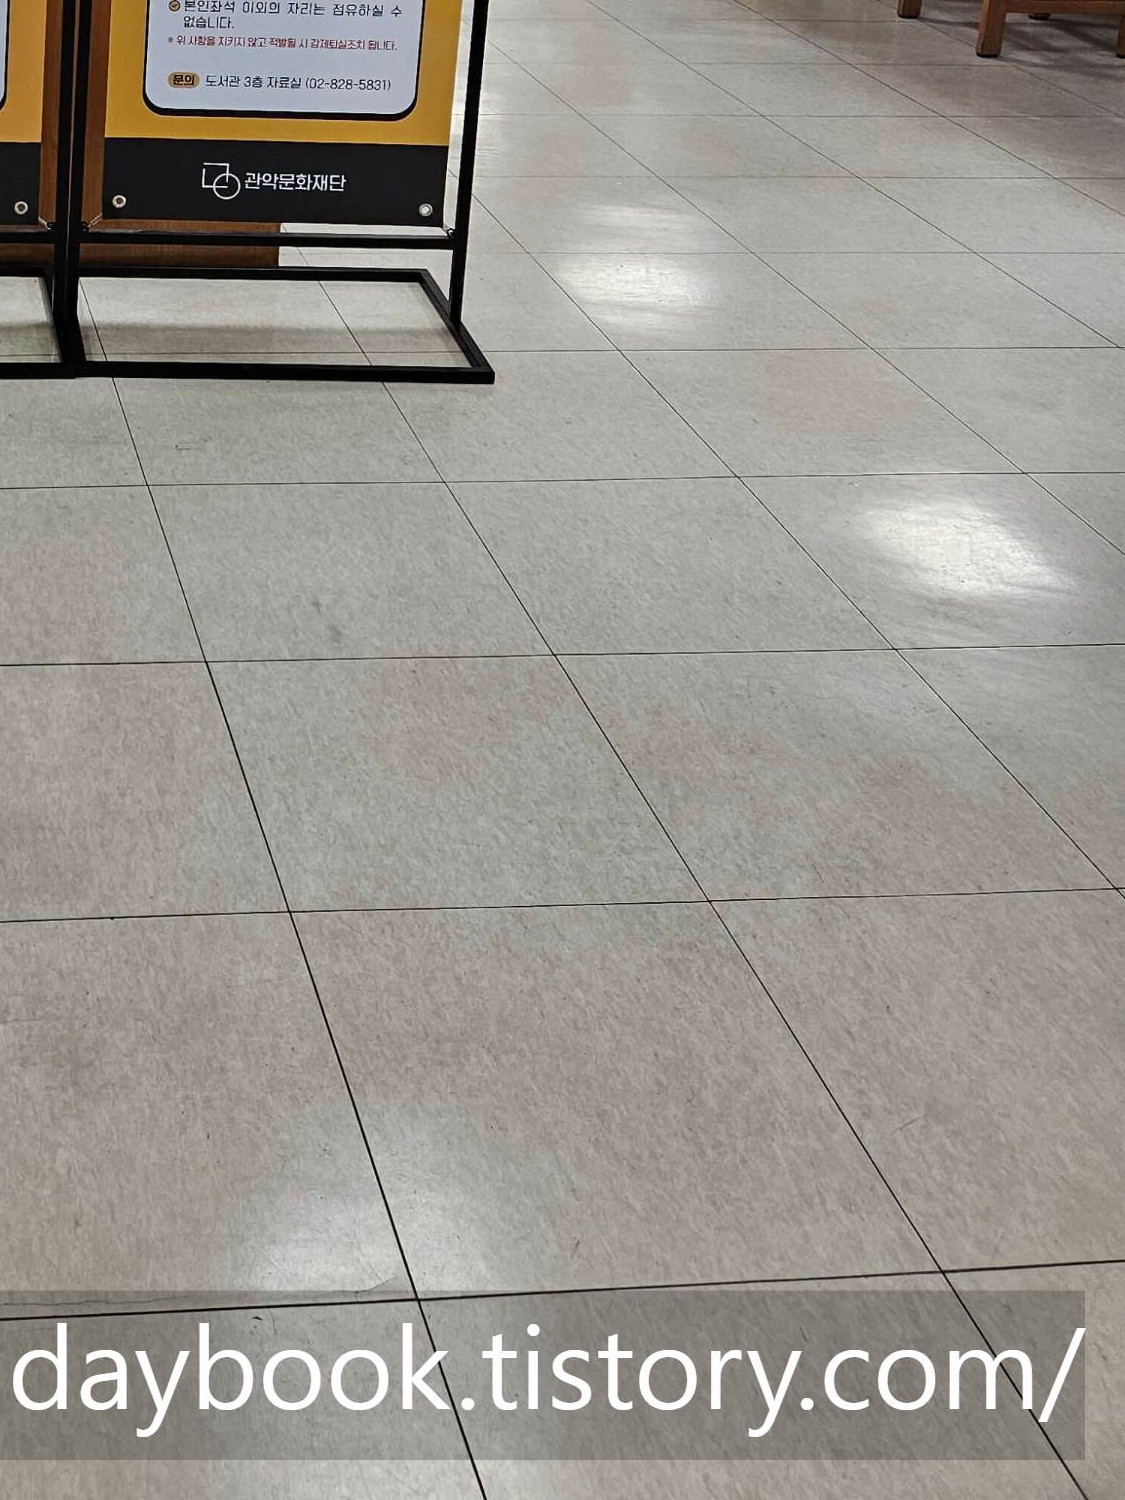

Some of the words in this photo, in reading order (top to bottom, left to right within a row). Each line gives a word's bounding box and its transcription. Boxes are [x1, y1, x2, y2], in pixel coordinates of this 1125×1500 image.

[172, 73, 195, 86] 문의
[205, 74, 241, 87] 도서관
[243, 75, 263, 88] 3층
[266, 75, 301, 89] 자료실
[304, 77, 391, 91] (02-828-5831)
[244, 171, 347, 192] 관악문화재단
